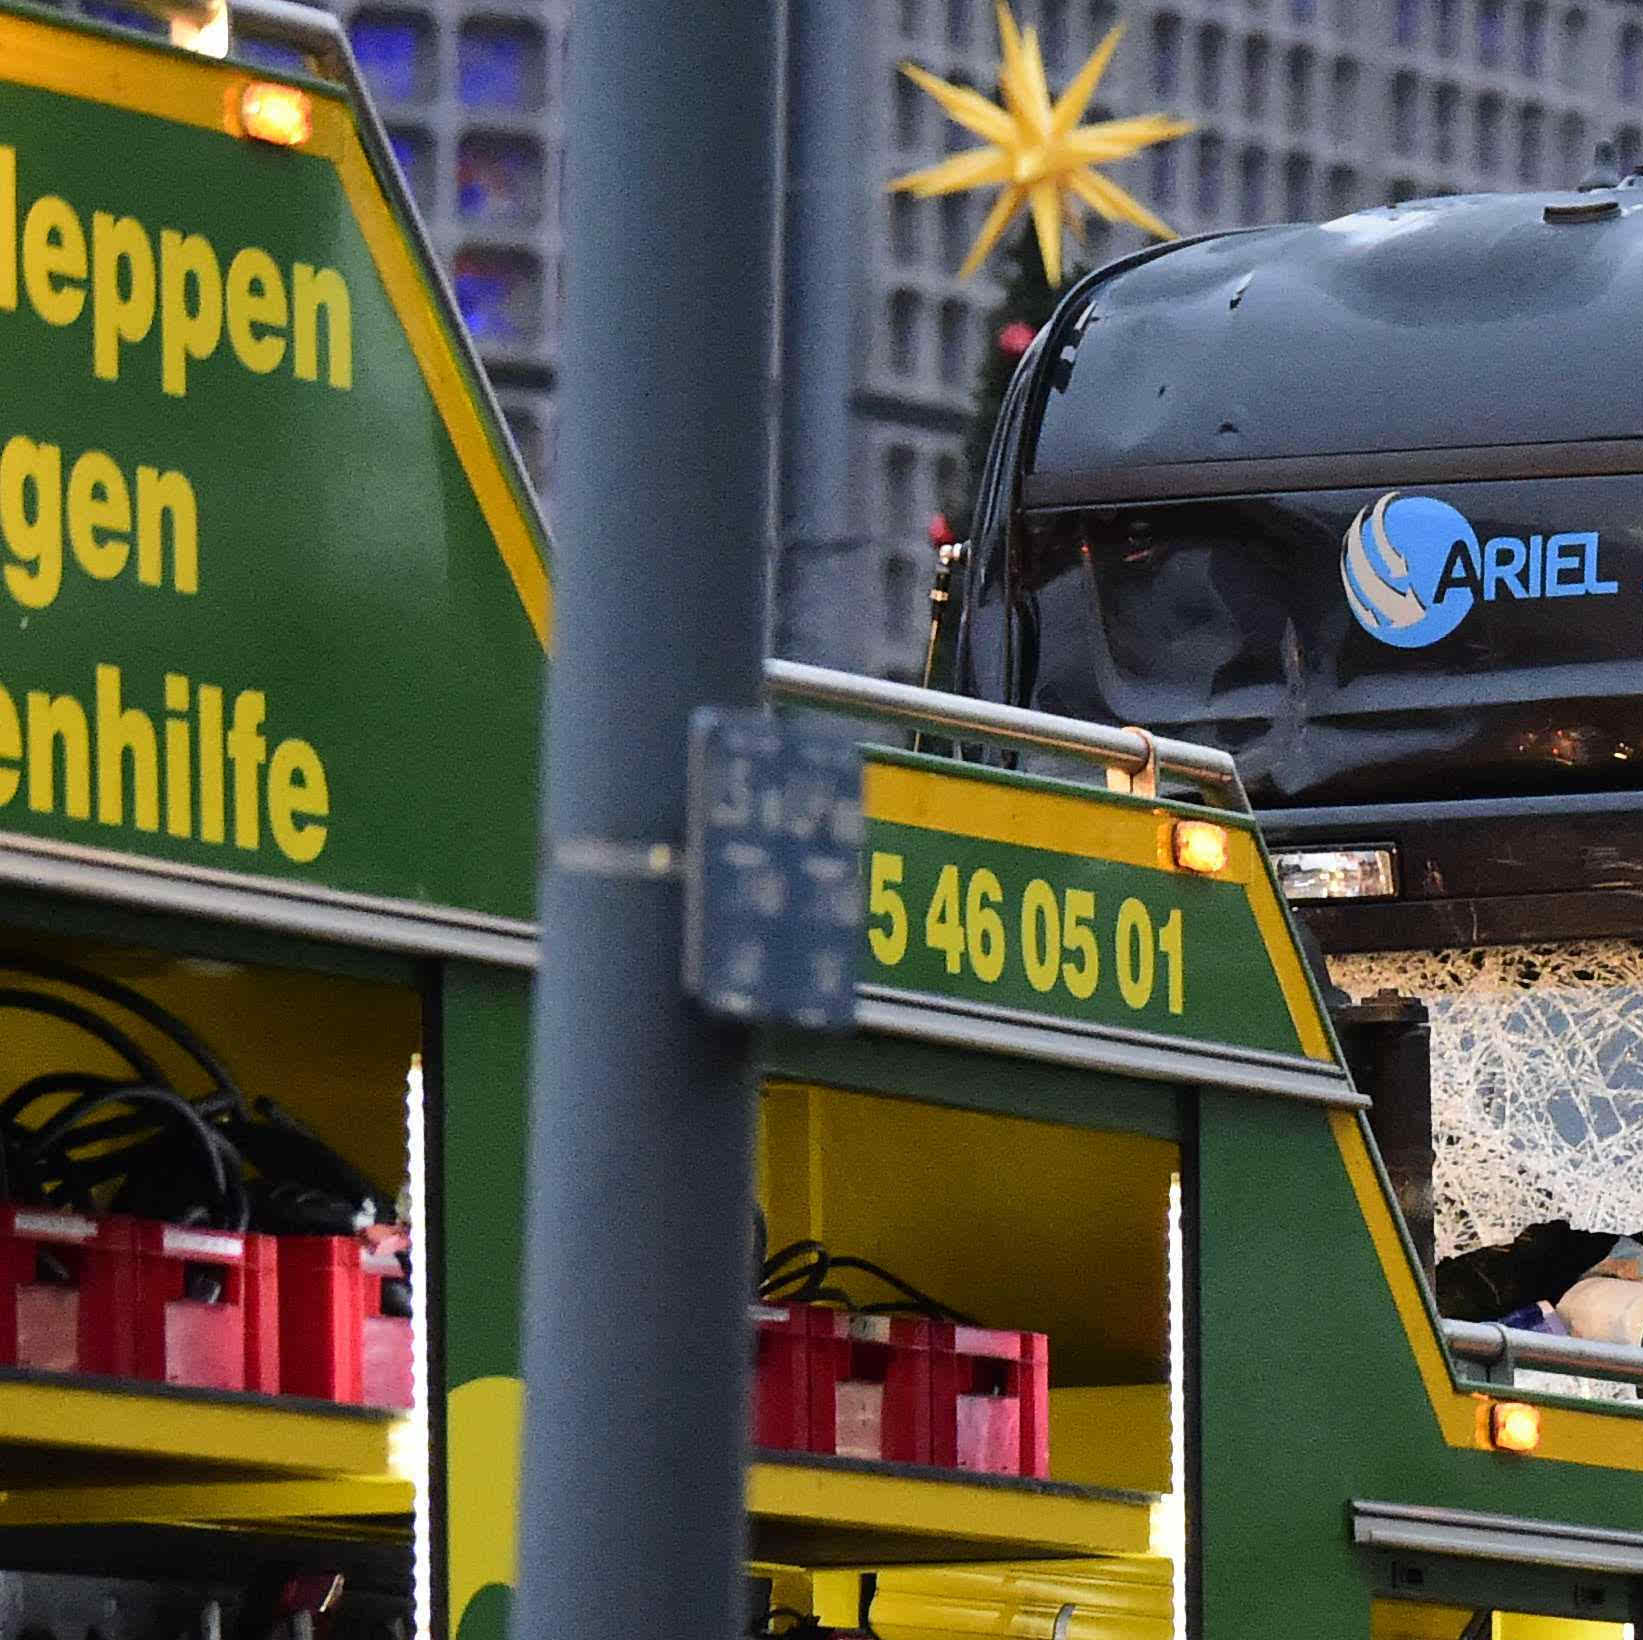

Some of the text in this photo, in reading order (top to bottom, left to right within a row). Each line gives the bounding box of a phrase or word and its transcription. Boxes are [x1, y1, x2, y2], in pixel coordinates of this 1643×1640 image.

[0, 433, 198, 608] gen
[1432, 530, 1618, 604] ARIEL
[926, 864, 1006, 983] 46
[1021, 878, 1099, 1000] 05
[1115, 896, 1184, 1016] 01
